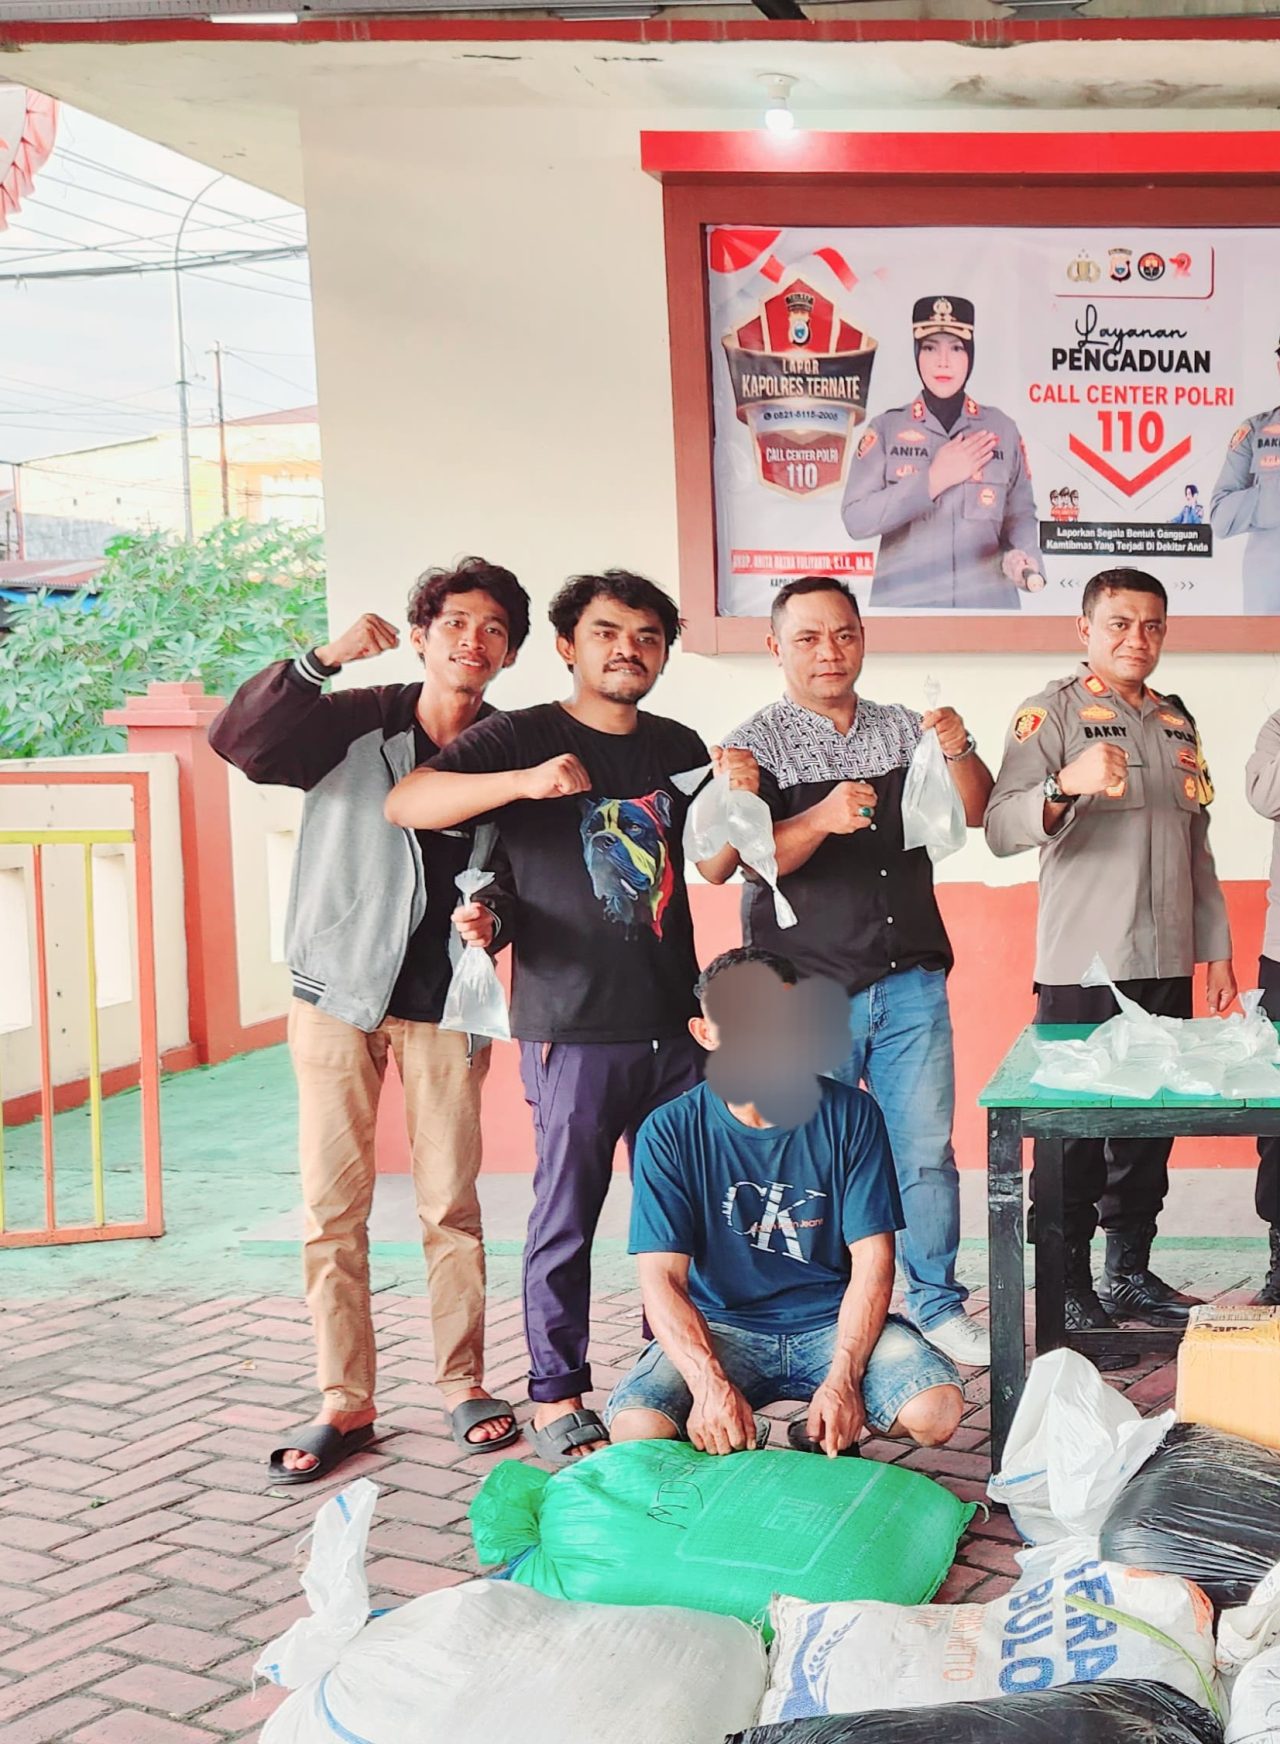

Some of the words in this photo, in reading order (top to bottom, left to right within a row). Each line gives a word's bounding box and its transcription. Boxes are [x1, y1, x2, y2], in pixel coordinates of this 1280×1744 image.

[1075, 304, 1188, 354] Layanan
[782, 358, 819, 374] LAPOR
[1052, 348, 1211, 373] PENGADUAN
[742, 374, 804, 398] KAPOLRES
[806, 376, 860, 399] TERNATE
[1029, 383, 1080, 404] CALL
[1087, 385, 1168, 405] CENTER
[1175, 386, 1234, 406] POLRI
[1097, 411, 1164, 453] 110
[766, 447, 785, 463] CALL
[786, 448, 815, 462] CENTER
[890, 446, 929, 458] ANITA
[787, 463, 817, 489] 110
[1057, 527, 1095, 539] Laporkan
[1097, 528, 1125, 540] Segala
[1126, 529, 1155, 539] Bentuk
[1157, 530, 1198, 541] Gangguan
[1046, 540, 1093, 550] Kamtibmas
[1094, 541, 1115, 552] Yang
[1116, 541, 1144, 552] Terjadi
[1146, 541, 1154, 551] Di
[1187, 543, 1209, 552] Anda
[1084, 726, 1127, 740] BAKRY
